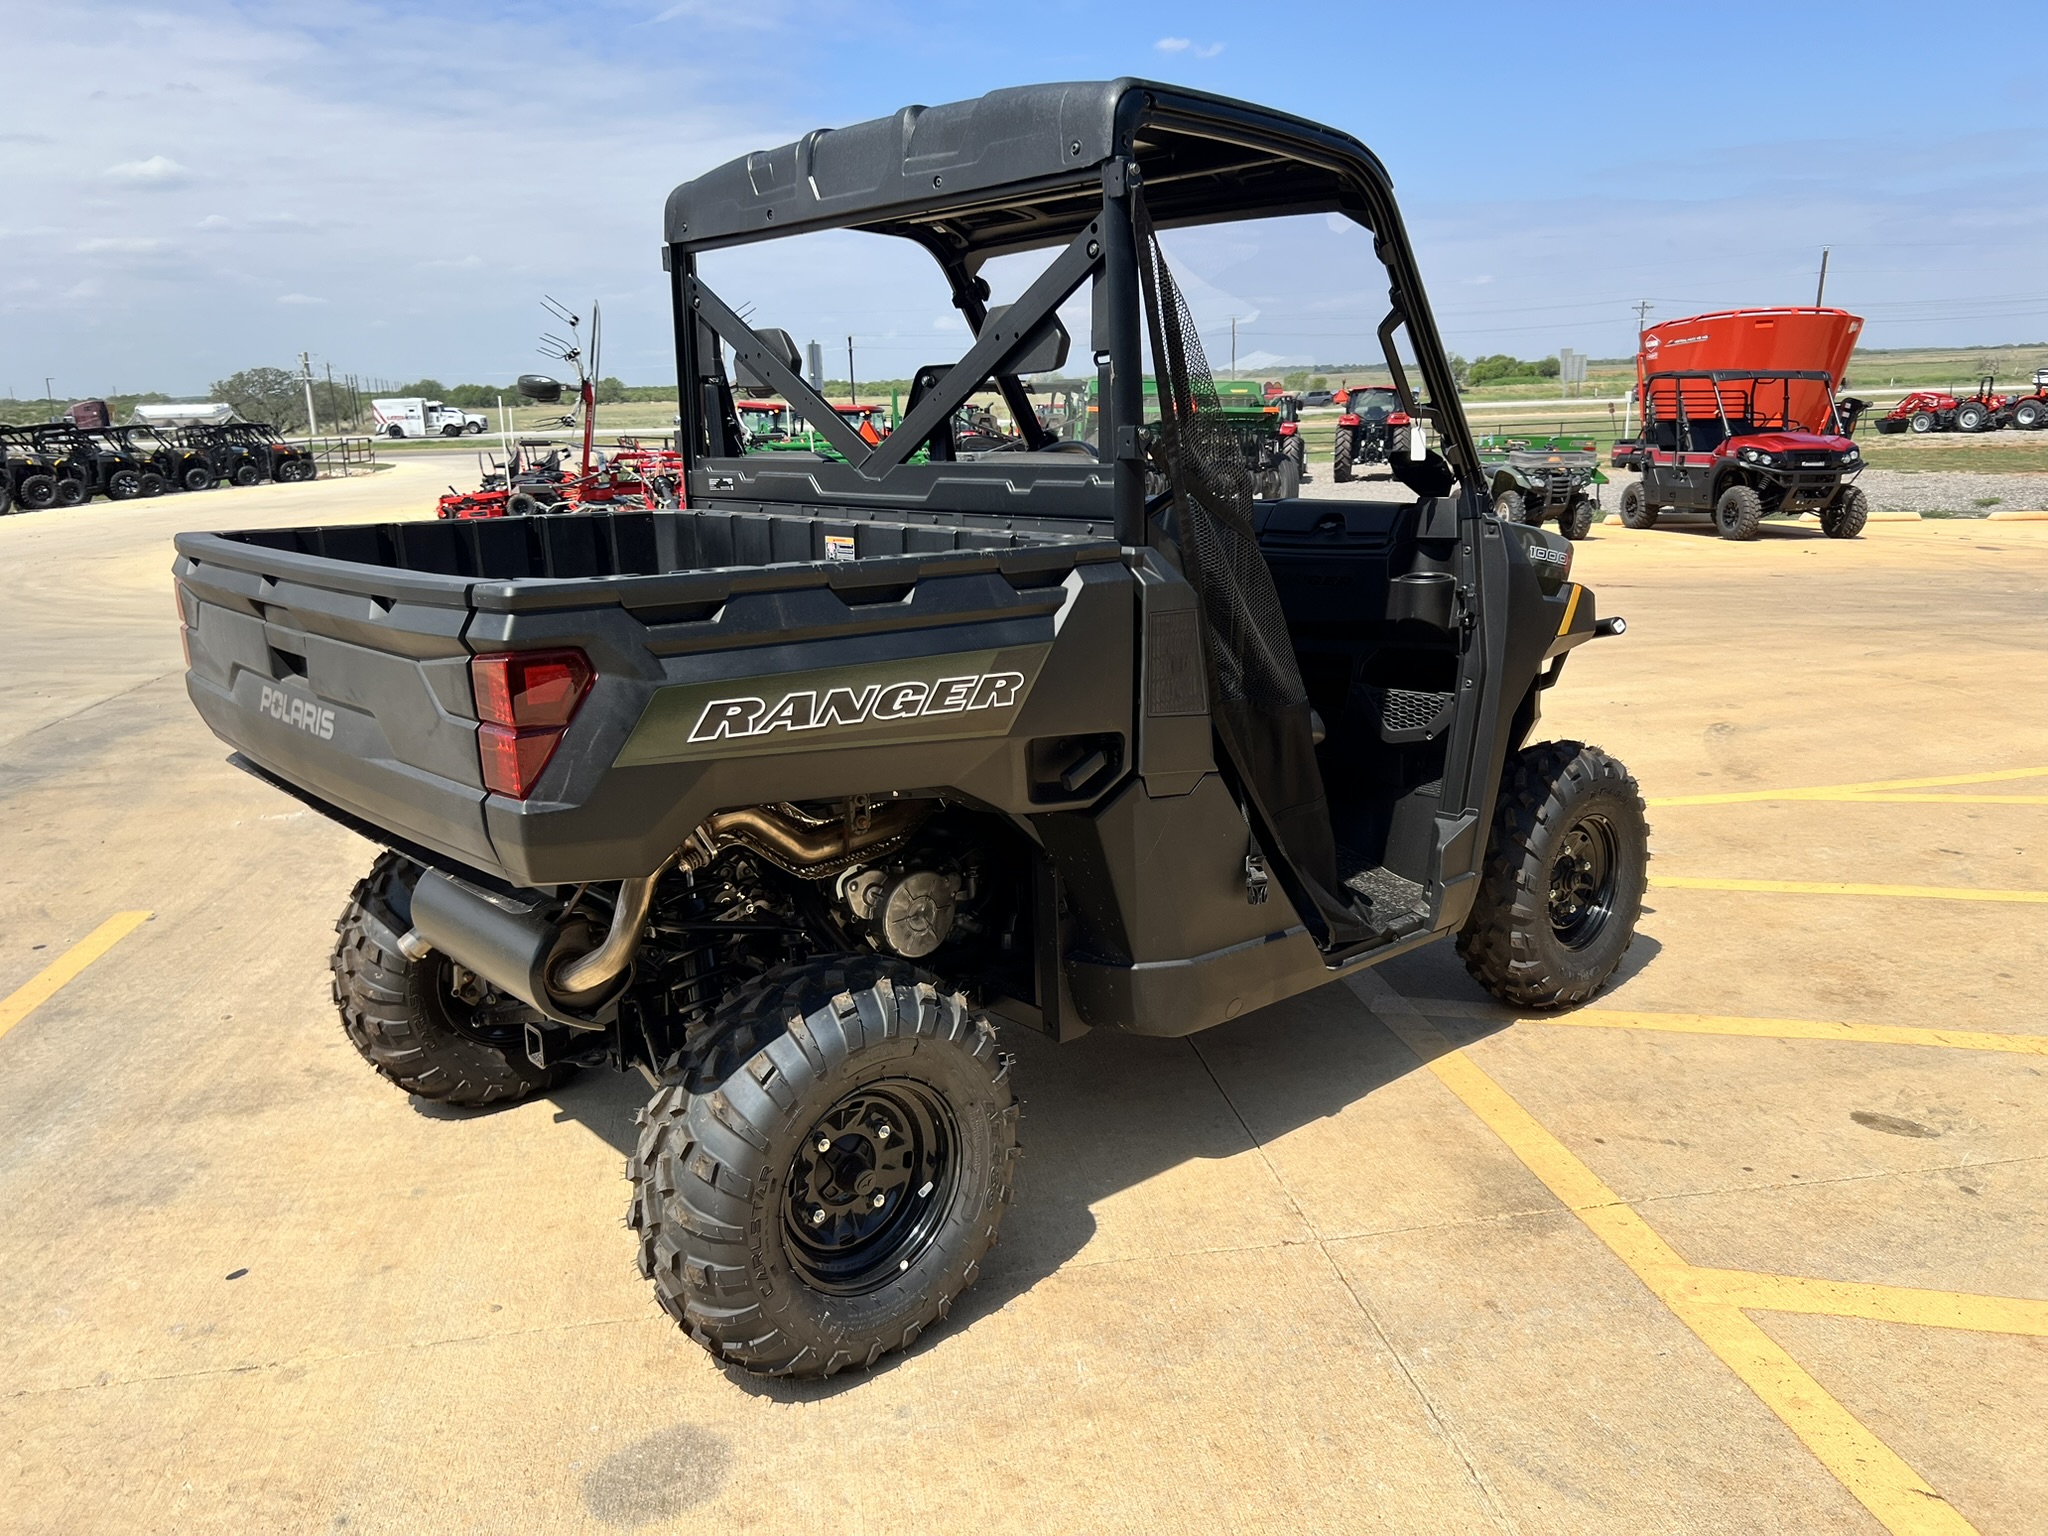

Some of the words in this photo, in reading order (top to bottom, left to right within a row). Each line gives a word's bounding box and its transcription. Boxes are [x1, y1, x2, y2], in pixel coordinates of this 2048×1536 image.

[1530, 545, 1567, 566] 1000
[260, 685, 335, 740] POLARIS
[687, 671, 1024, 743] RANGER
[750, 1165, 775, 1298] CARLSTAR
